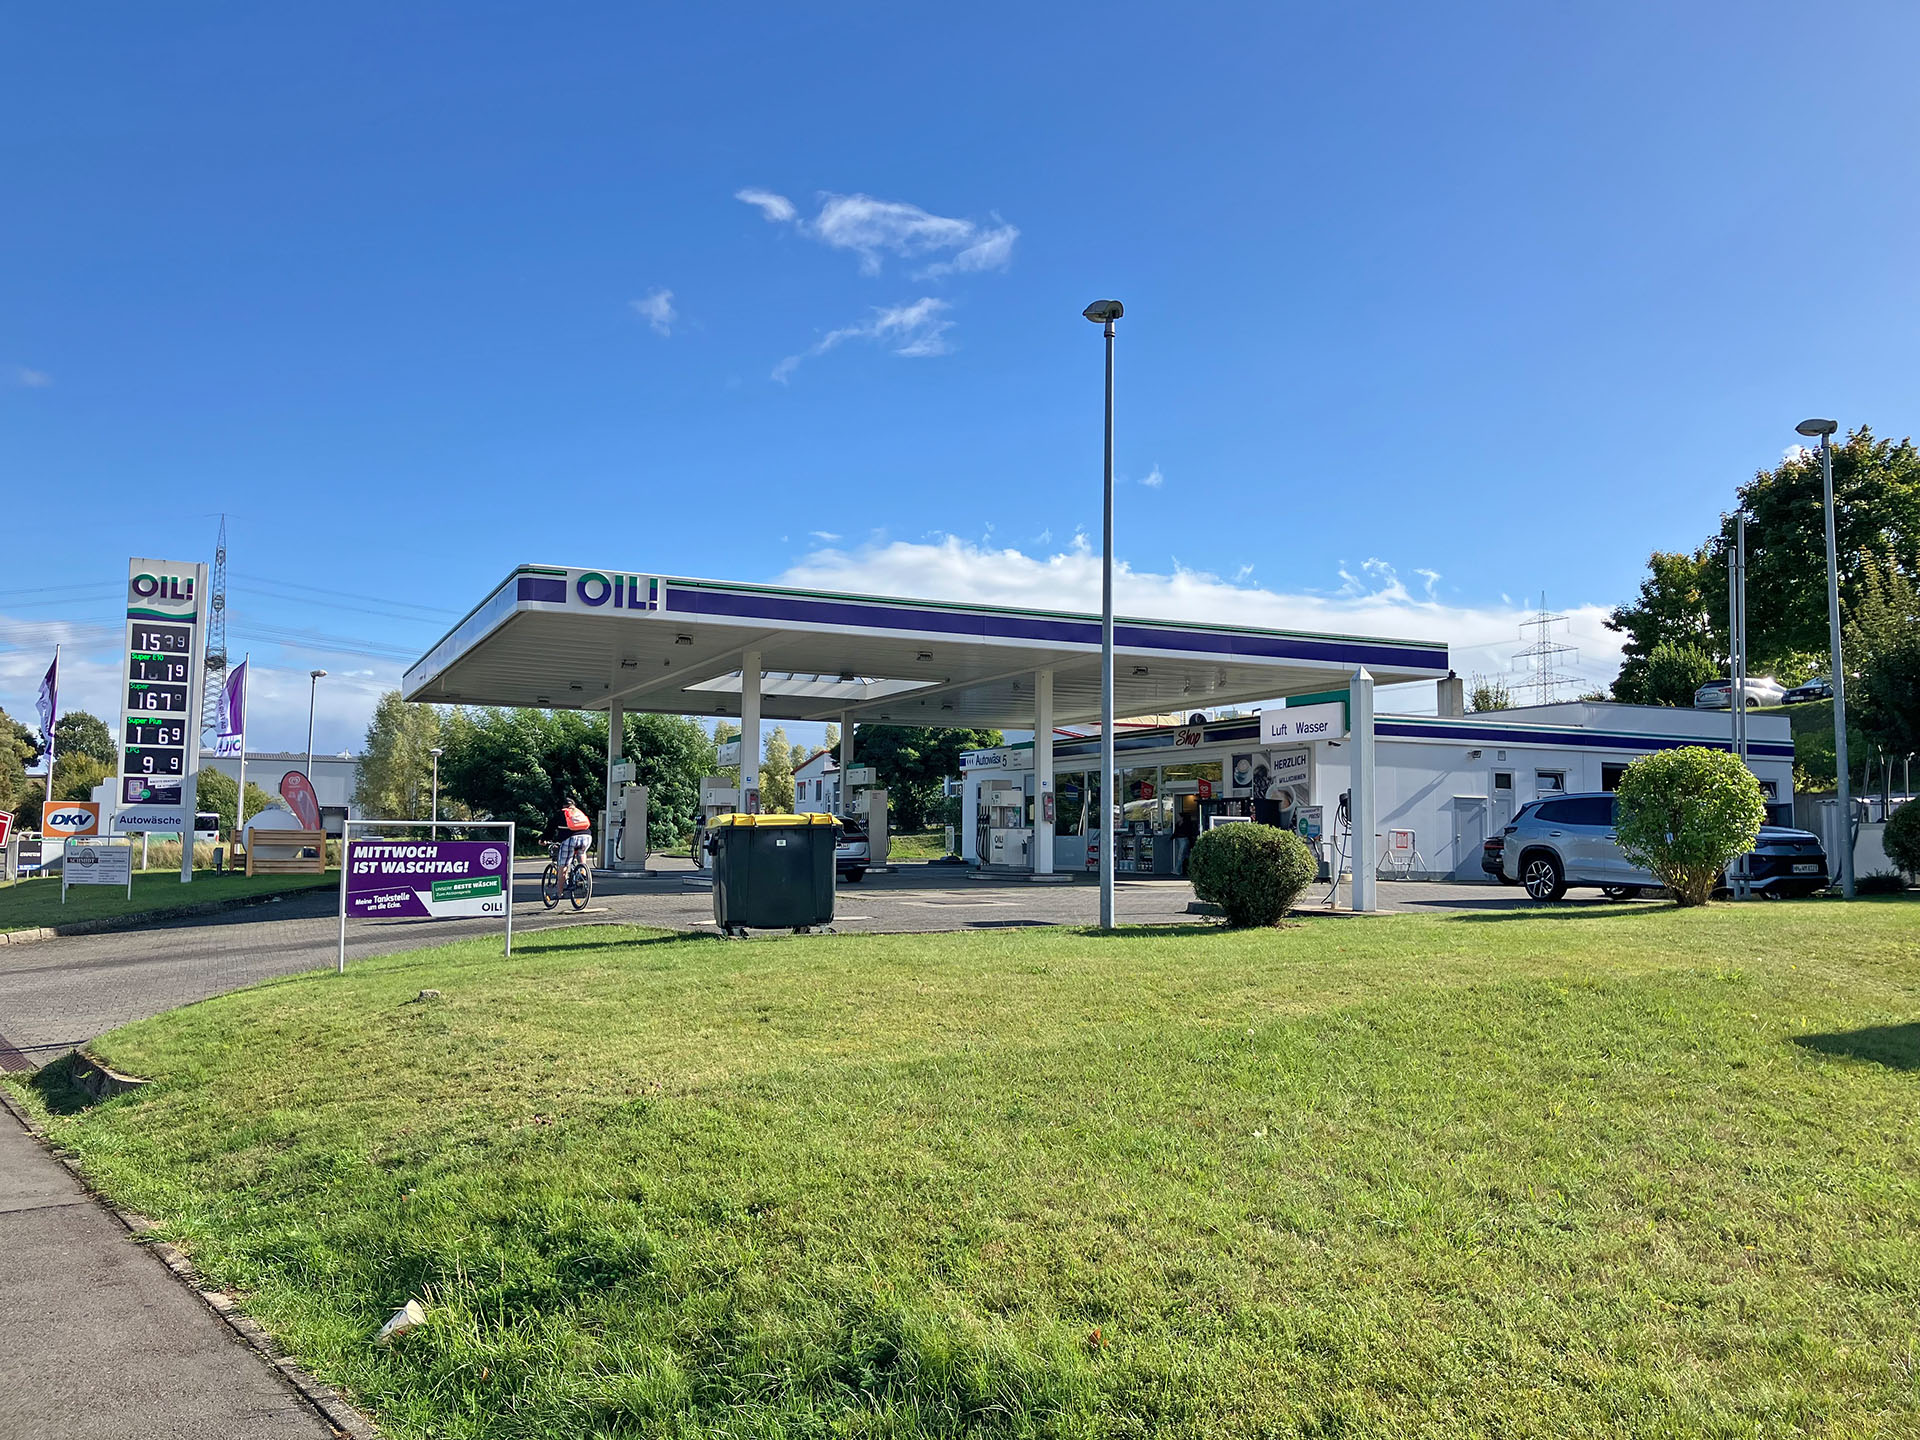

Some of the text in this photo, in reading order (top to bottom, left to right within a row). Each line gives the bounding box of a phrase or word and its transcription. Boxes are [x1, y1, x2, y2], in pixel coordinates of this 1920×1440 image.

[132, 574, 194, 600] OIL!
[576, 572, 659, 611] OIL!
[131, 653, 151, 661] Super
[129, 682, 150, 691] Super
[127, 716, 162, 725] Super Plus
[1271, 721, 1329, 737] Luft Wasser
[1175, 729, 1202, 748] Shop
[1002, 754, 1008, 767] 5
[1273, 755, 1307, 771] HERZLICH
[50, 814, 92, 826] DKV
[119, 815, 182, 825] Autowäsche
[353, 846, 438, 858] MITTWOCH
[352, 861, 470, 874] IST WASCHTAG!
[472, 880, 498, 888] WÄSCHE
[373, 892, 410, 903] Tankstelle
[481, 902, 503, 912] OIL!
